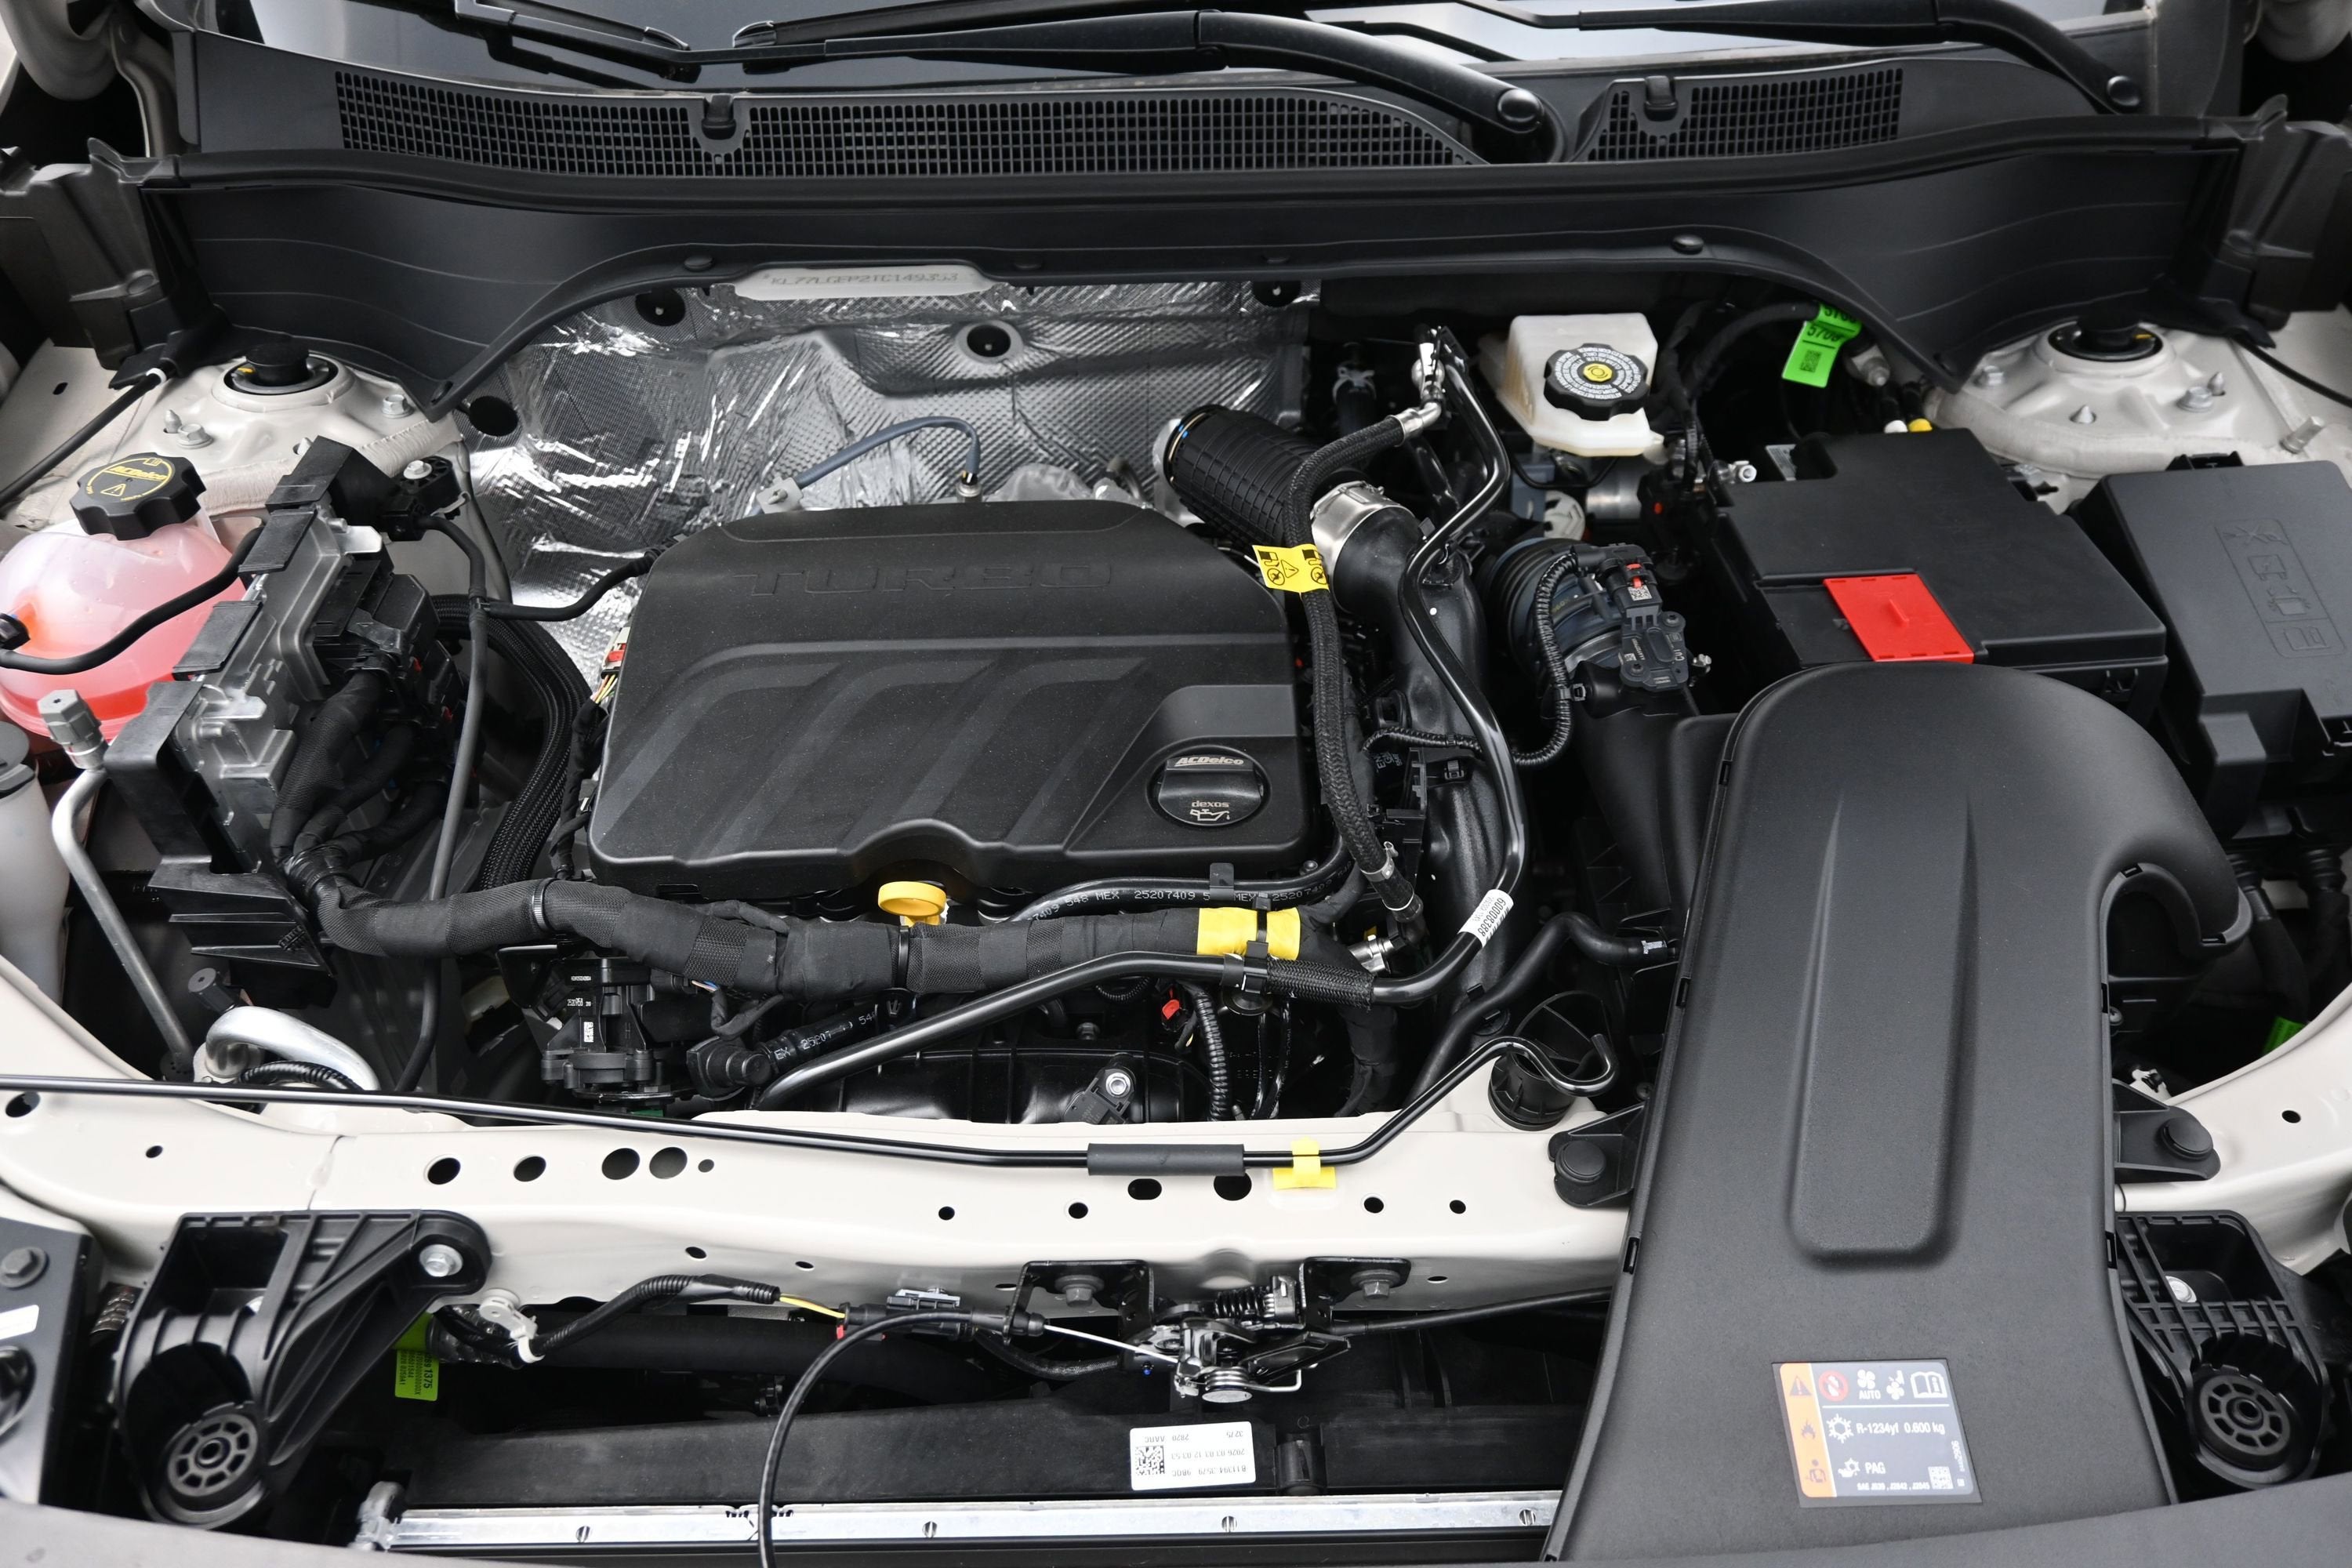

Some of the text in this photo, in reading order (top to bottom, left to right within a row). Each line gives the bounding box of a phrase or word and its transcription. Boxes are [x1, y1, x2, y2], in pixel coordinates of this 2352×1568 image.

[732, 564, 1112, 596] TURBO
[1174, 756, 1245, 767] ACDelco
[1191, 800, 1230, 808] dexos
[1095, 891, 1120, 901] MEX
[1134, 890, 1196, 900] 25207409
[1477, 898, 1506, 937] 60008388
[1858, 1389, 1882, 1399] AUTO
[1904, 1421, 1931, 1433] 0.600
[1933, 1422, 1946, 1436] kg
[1864, 1461, 1886, 1474] PAG
